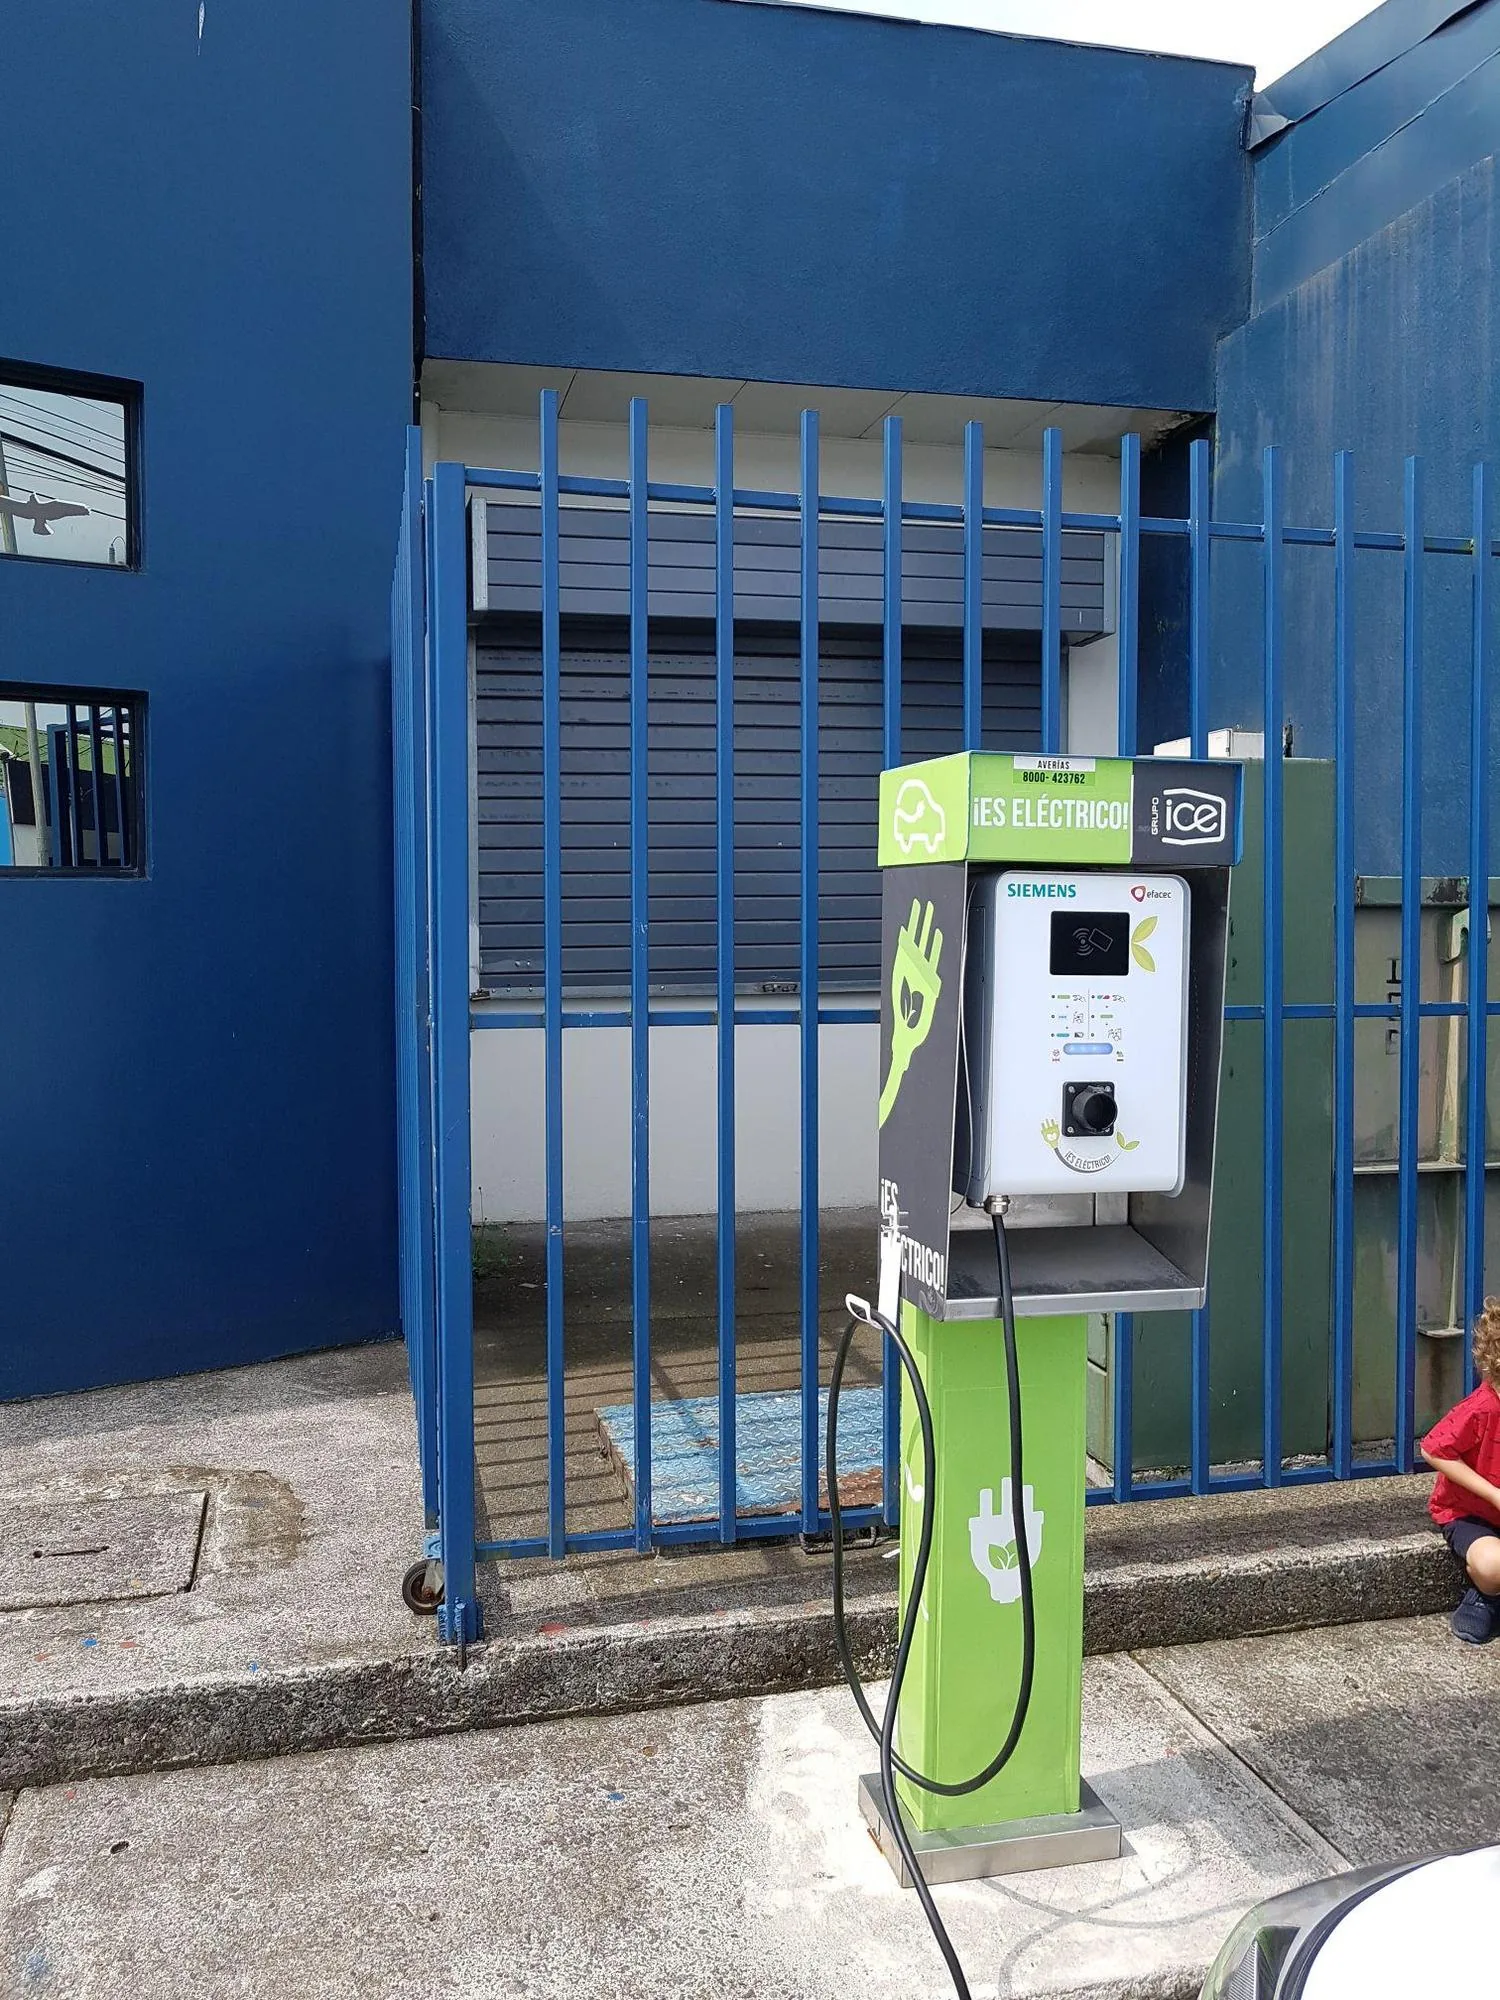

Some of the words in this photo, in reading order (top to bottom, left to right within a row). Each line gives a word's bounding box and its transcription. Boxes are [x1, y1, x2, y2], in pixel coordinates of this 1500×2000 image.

[1052, 772, 1086, 785] 423762
[1012, 793, 1129, 830] ELÉCTRICO!
[1151, 796, 1160, 835] GRUPO
[1007, 883, 1077, 898] SIEMENS
[1146, 890, 1173, 900] efacec
